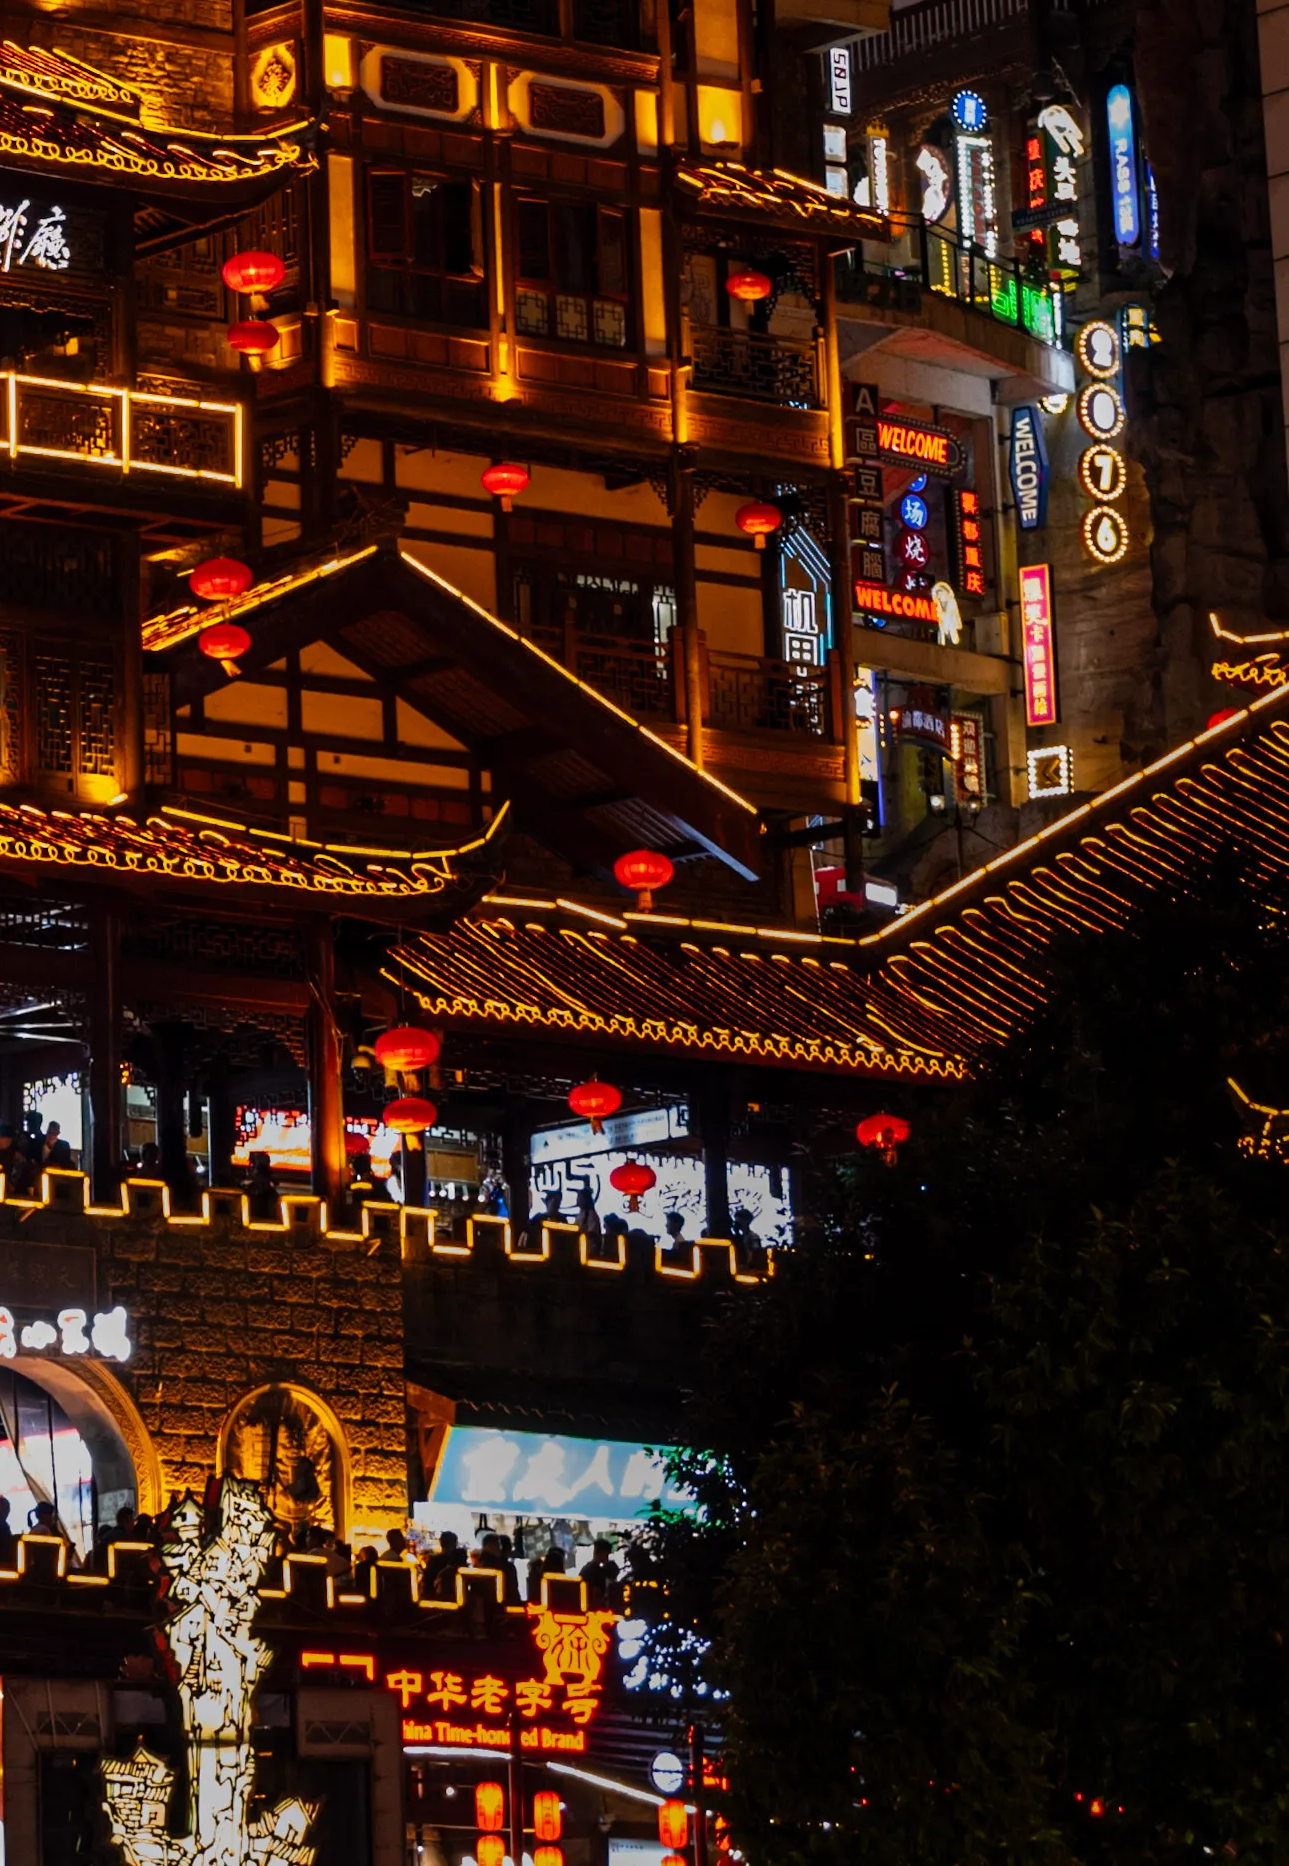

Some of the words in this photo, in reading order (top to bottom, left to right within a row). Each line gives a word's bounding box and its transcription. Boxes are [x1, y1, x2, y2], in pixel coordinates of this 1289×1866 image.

[877, 421, 948, 465] WELCOME
[1014, 417, 1038, 522] WELCOME
[386, 1669, 603, 1725] 中华老字号
[402, 1719, 433, 1741] hina
[435, 1721, 539, 1747] Time-honed
[541, 1727, 586, 1752] Brand
